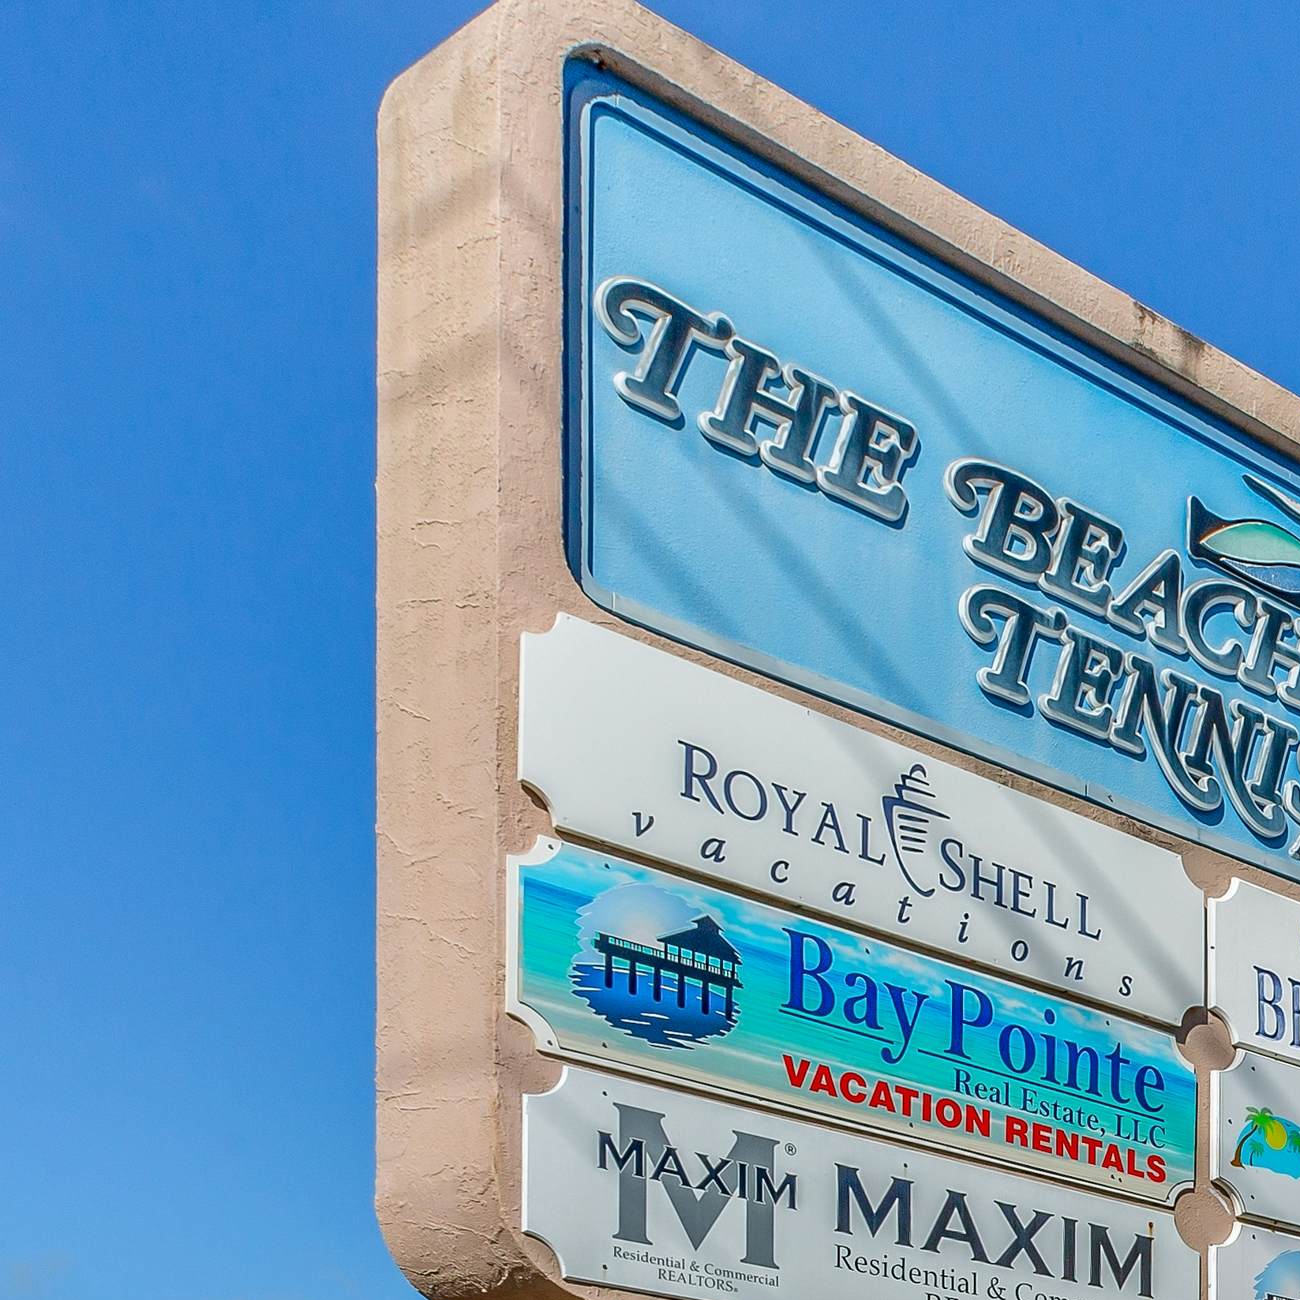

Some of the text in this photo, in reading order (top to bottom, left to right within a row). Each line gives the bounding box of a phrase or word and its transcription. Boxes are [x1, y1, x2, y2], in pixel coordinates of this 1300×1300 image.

[594, 275, 918, 525] THE
[678, 739, 1102, 941] ROYAL SHELL
[780, 927, 1166, 1114] Bay Pointe
[597, 1130, 798, 1211] MAXIM
[781, 1054, 1168, 1184] VACATION RENTALS
[953, 1067, 1167, 1149] Real Estate, LLC
[613, 1246, 780, 1288] Residential & Commercial
[833, 1162, 1155, 1299] MAXIM
[833, 1244, 978, 1297] Residential
[987, 1276, 1007, 1300] &
